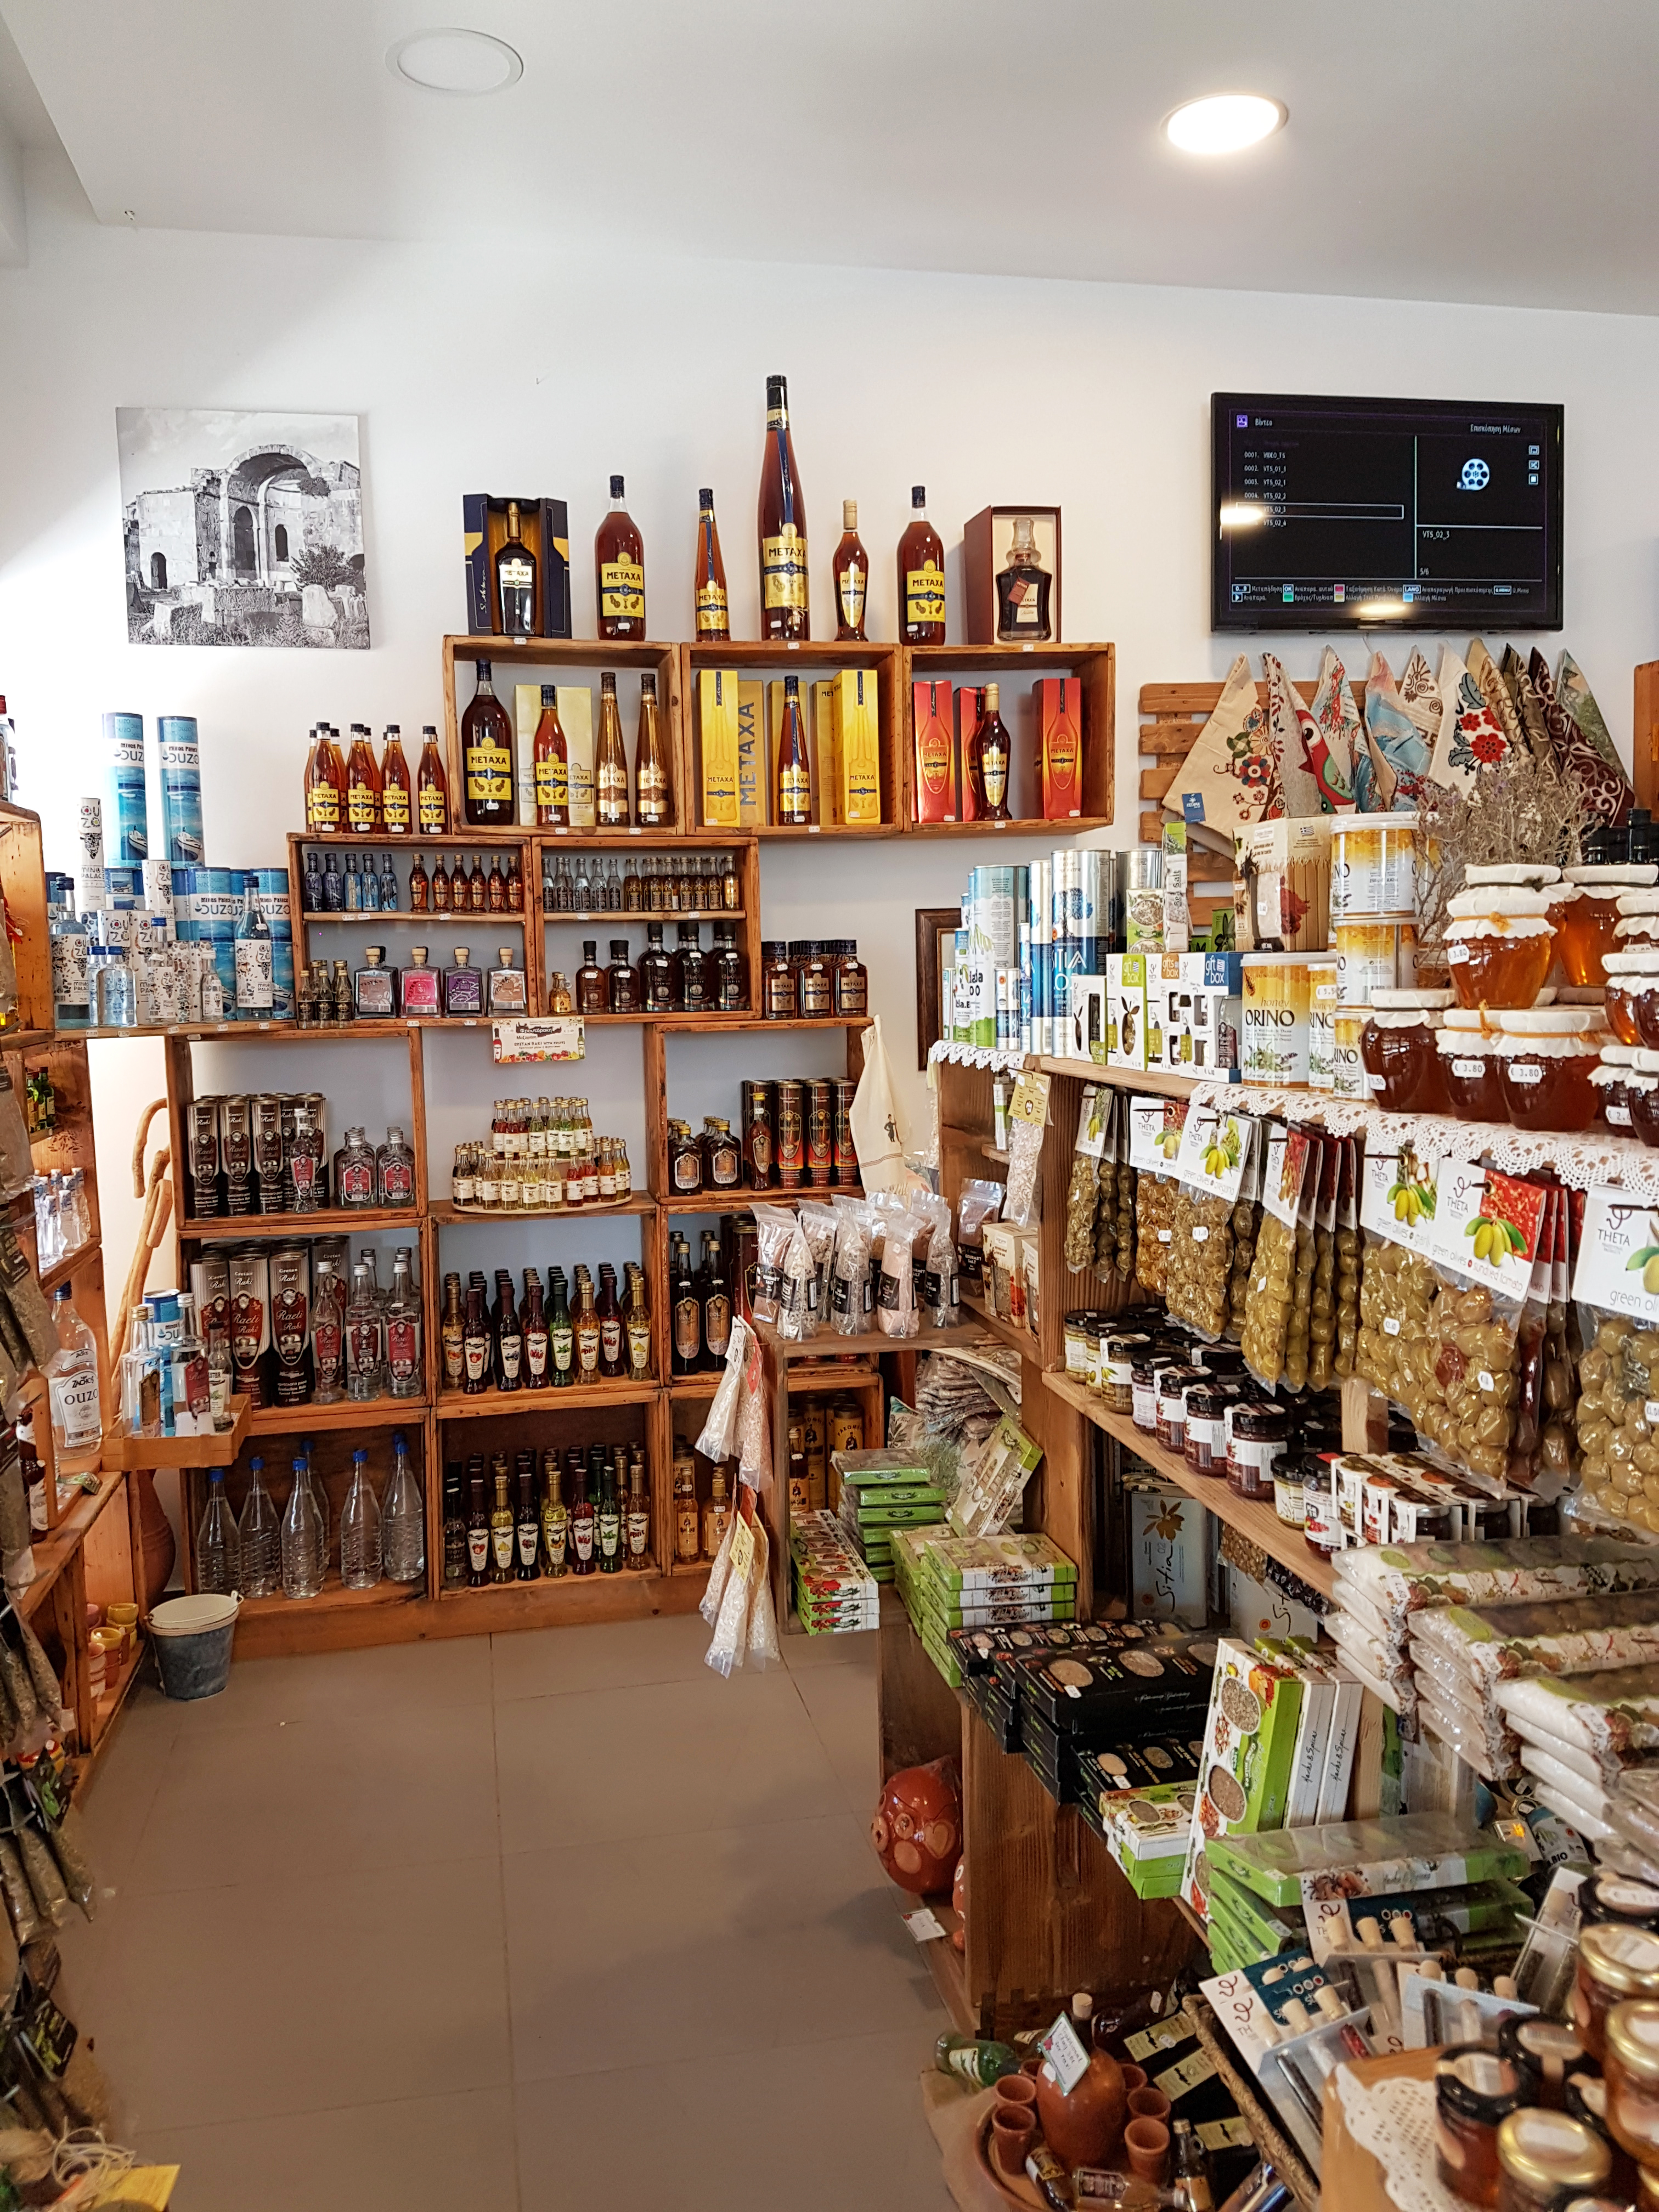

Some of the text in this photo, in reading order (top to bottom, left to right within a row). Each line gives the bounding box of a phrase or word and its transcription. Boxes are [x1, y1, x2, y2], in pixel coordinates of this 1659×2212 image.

[1423, 531, 1450, 540] VTS_02_3
[769, 548, 806, 557] METAXA
[607, 572, 641, 580] METAXA
[913, 579, 943, 587] METAXA
[738, 702, 757, 805] METAXA
[471, 756, 506, 765] METAXA
[1173, 870, 1182, 907] Sea Salt
[1205, 955, 1216, 976] gift
[1166, 968, 1179, 978] box
[1210, 972, 1225, 984] box
[1261, 997, 1290, 1010] honey
[1245, 1009, 1295, 1027] ORINO
[1137, 1122, 1156, 1132] THETA
[1189, 1131, 1203, 1143] THETA
[1372, 1170, 1389, 1183] THETA
[1447, 1196, 1469, 1213] THETA
[1598, 1228, 1630, 1247] THETA
[1431, 1244, 1523, 1292] green olives sundried tomato
[235, 1277, 253, 1285] Raki
[279, 1273, 298, 1283] Raki
[1610, 1290, 1641, 1308] green
[64, 1388, 98, 1405] OUZO
[1156, 1541, 1175, 1613] Sitia
[1272, 1593, 1291, 1635] Sit
